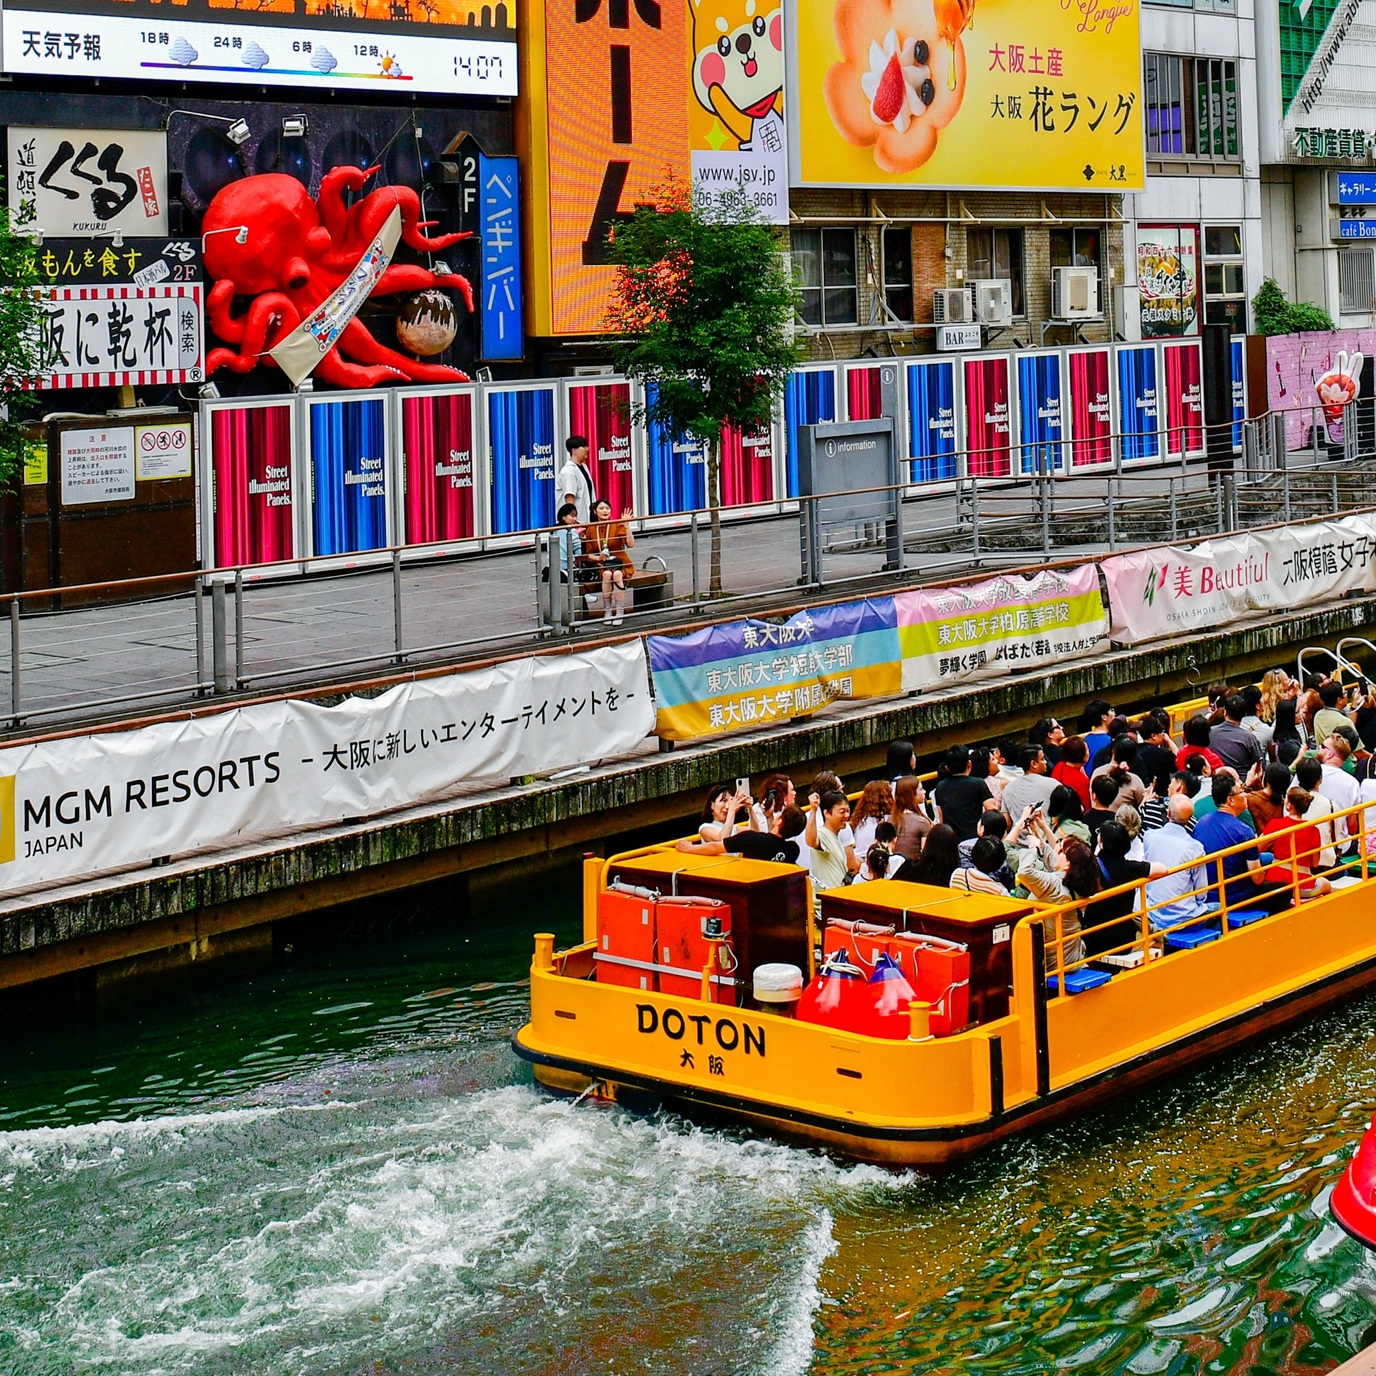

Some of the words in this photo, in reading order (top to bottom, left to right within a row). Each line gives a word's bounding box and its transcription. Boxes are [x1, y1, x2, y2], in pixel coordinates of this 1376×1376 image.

[1077, 1, 1135, 35] Langue
[22, 31, 102, 63] 天気予報
[140, 31, 170, 47] 18時
[213, 36, 242, 51] 24時
[292, 39, 314, 54] 6時
[353, 44, 379, 59] 12時
[988, 43, 1064, 77] 大阪土産
[990, 95, 1022, 120] 大阪
[1029, 86, 1136, 135] 花ラング
[699, 165, 776, 184] www.jsv.jp
[1339, 182, 1371, 196] ギャラリー
[1341, 223, 1357, 236] café
[1359, 221, 1376, 236] Bon
[485, 173, 516, 339] ペンギンバー
[173, 264, 197, 281] 2F
[39, 301, 173, 370] 阪に乾杯
[180, 310, 195, 354] 検索
[945, 331, 964, 345] BAR
[938, 407, 952, 418] Street
[533, 442, 552, 456] Street
[610, 435, 628, 448] Street
[837, 440, 876, 452] information
[360, 457, 382, 471] Street
[450, 449, 469, 462] Street
[266, 465, 288, 479] Street
[451, 474, 472, 488] Panels.
[362, 483, 385, 497] Panels.
[267, 492, 292, 507] Panels.
[1174, 565, 1193, 599] 美
[1200, 552, 1269, 595] Beautiful
[1192, 606, 1216, 618] SHOIN
[939, 650, 986, 676] 夢輝く学園
[24, 784, 112, 832] MGM
[124, 751, 281, 813] RESORTS
[24, 831, 84, 859] JAPAN
[636, 1003, 766, 1057] DOTON
[681, 1047, 725, 1077] 大阪
